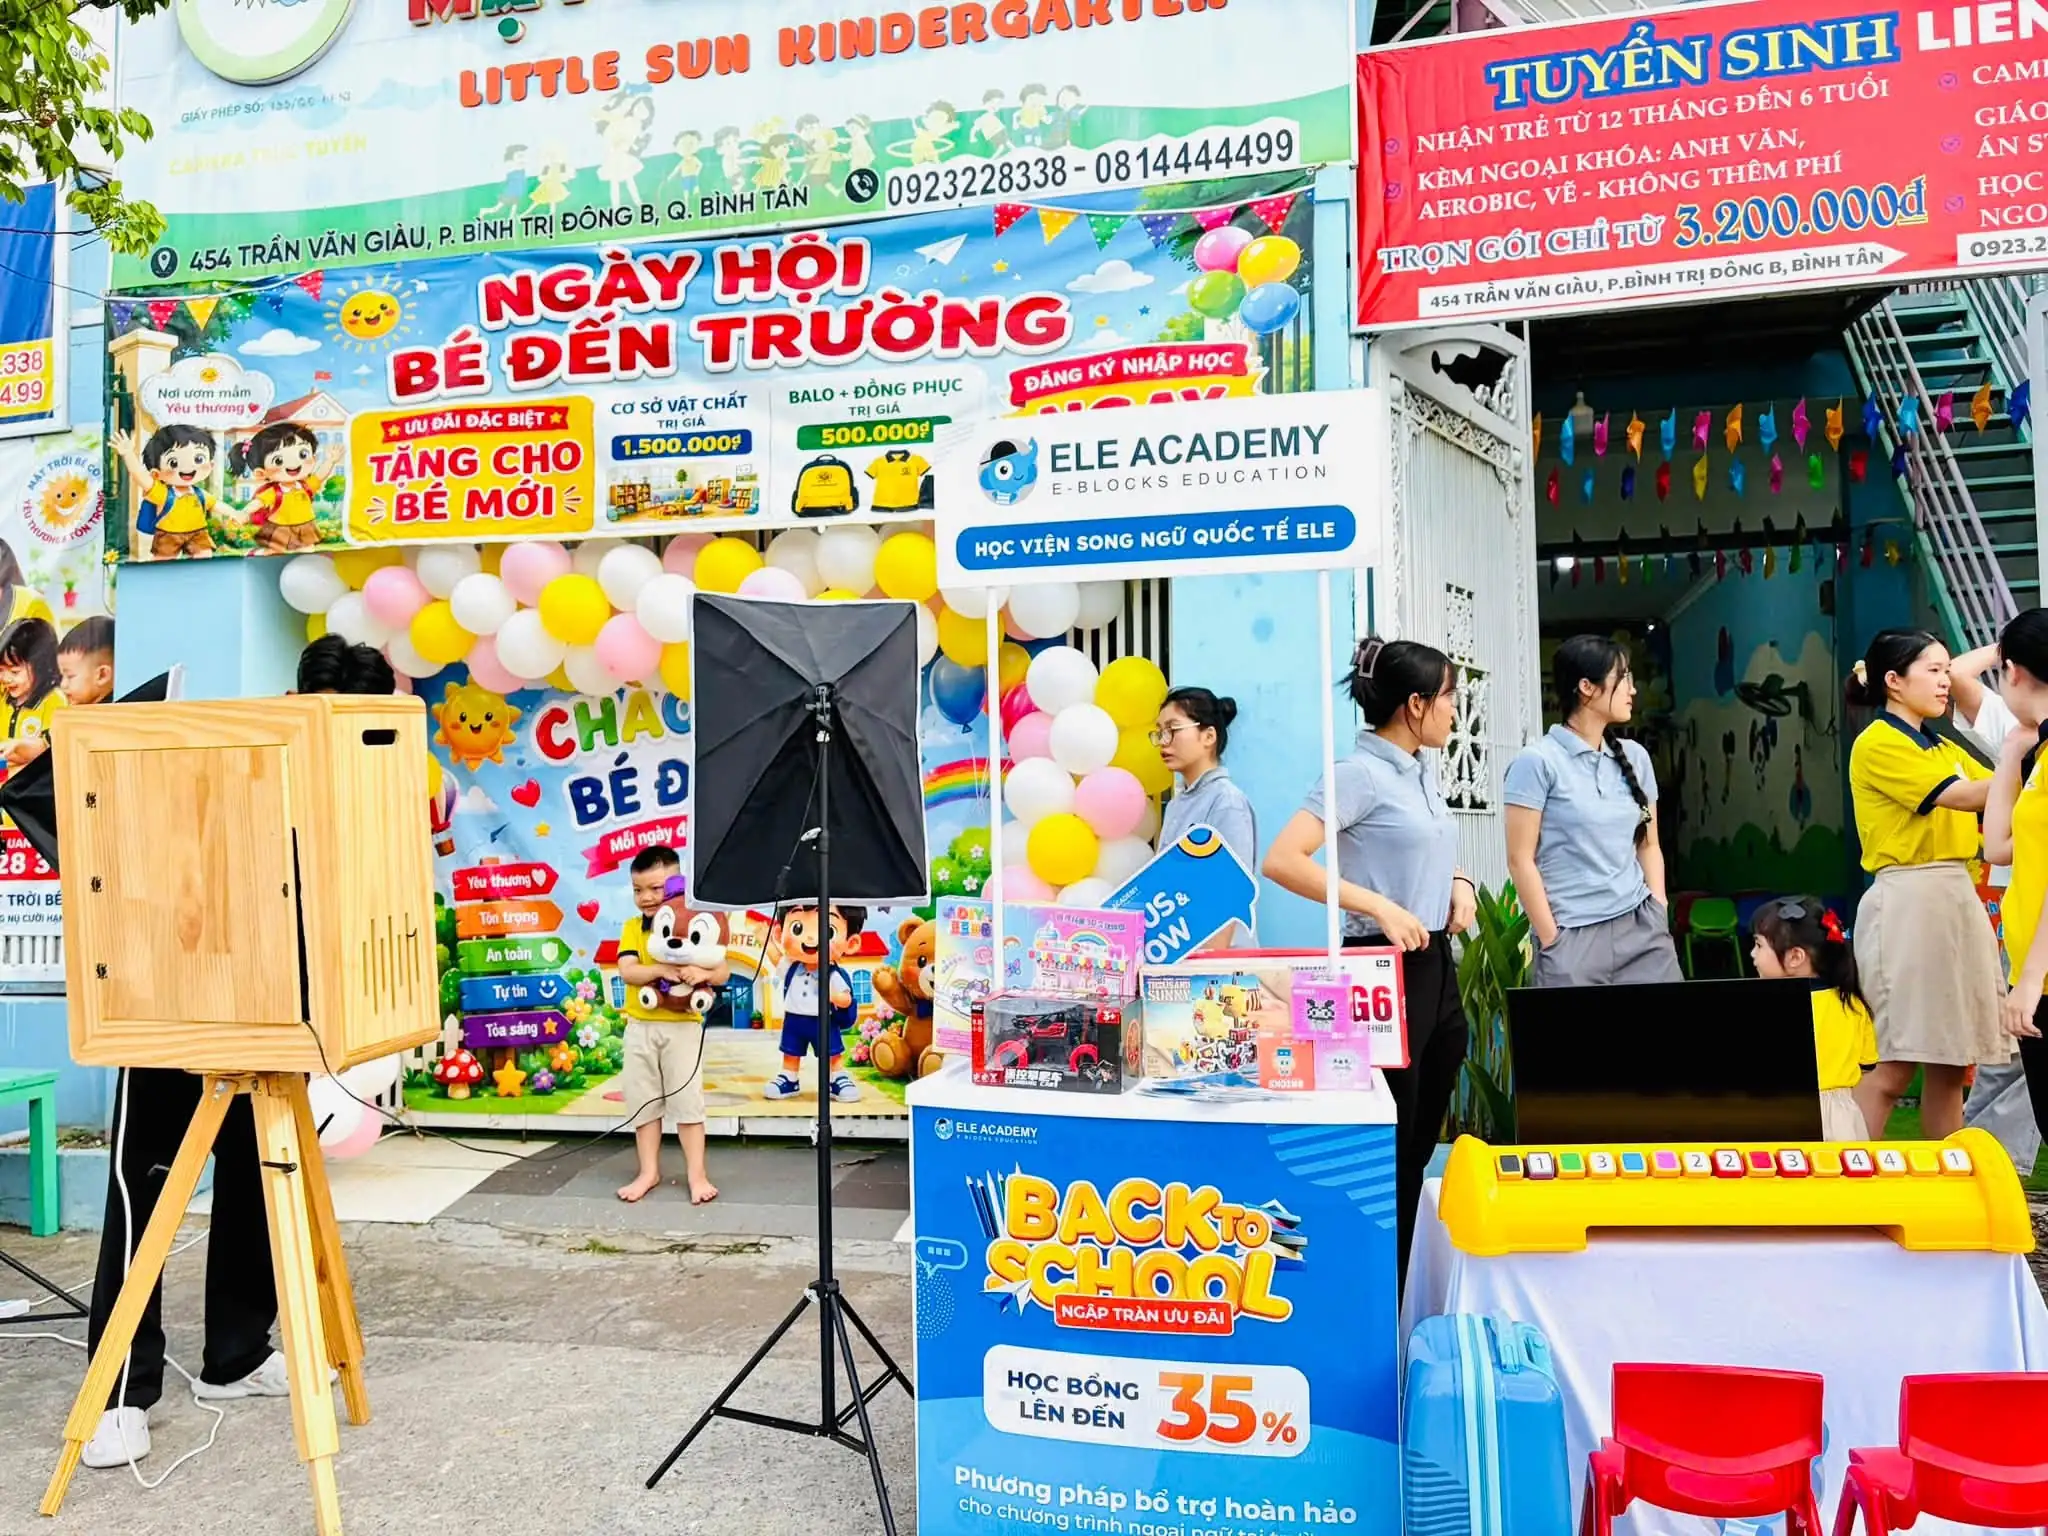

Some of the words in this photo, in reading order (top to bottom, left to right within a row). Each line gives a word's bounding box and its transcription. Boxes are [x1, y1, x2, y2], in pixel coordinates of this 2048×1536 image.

[460, 51, 619, 107] LITTLE
[646, 34, 750, 84] SUN
[1490, 25, 1706, 106] TUYỂN
[1726, 17, 1893, 76] SINH
[1416, 125, 1494, 153] NHẬN
[1500, 114, 1549, 141] TRẺ
[1555, 111, 1592, 134] TỪ
[1599, 111, 1623, 130] 12
[1628, 96, 1728, 124] THÁNG
[1736, 84, 1792, 114] ĐẾN
[1800, 90, 1813, 107] 6
[1819, 72, 1889, 103] TUỔI
[1975, 98, 2048, 127] GIÁO
[1418, 165, 1474, 191] KÈM
[1480, 155, 1568, 183] NGOẠI
[1576, 146, 1663, 174] KHÓA:
[1668, 138, 1729, 160] ANH
[1739, 127, 1805, 151] VĂN,
[1976, 134, 2019, 158] ÁN
[887, 155, 1068, 207] 0923228338
[1094, 129, 1295, 184] 0814444499
[1418, 191, 1537, 221] AEROBIC,
[1544, 181, 1577, 204] VẼ
[1598, 170, 1700, 200] KHÔNG
[1707, 160, 1787, 187] THÊM
[1796, 151, 1843, 176] PHÍ
[1978, 171, 2044, 199] HỌC
[190, 248, 232, 271] 454
[239, 234, 301, 266] TRẦN
[308, 230, 356, 258] VĂN
[364, 221, 432, 253] GIÀU,
[439, 227, 456, 246] P.
[463, 215, 514, 242] BÌNH
[520, 214, 553, 241] TRỊ
[561, 204, 633, 232] ĐÔNG
[640, 204, 660, 227] B,
[667, 200, 693, 220] Q.
[700, 190, 754, 217] BÌNH
[762, 184, 808, 209] TÂN
[1379, 239, 1469, 274] TRỌN
[1478, 229, 1540, 260] GÓI
[1546, 217, 1610, 253] CHỈ
[1615, 212, 1666, 245] TỪ
[485, 251, 695, 324] NGÀY
[721, 236, 868, 303] HỘI
[1431, 295, 1460, 308] 454
[1465, 281, 1511, 304] TRẦN
[1515, 282, 1550, 300] VĂN
[1555, 274, 1603, 297] GIÀU,
[1608, 268, 1672, 291] P.BÌNH
[1677, 268, 1705, 286] TRỊ
[1710, 258, 1764, 280] ĐÔNG
[1770, 261, 1787, 276] B,
[1792, 253, 1841, 272] BÌNH
[1846, 250, 1884, 267] TÂN
[392, 332, 485, 396] BÉ
[508, 313, 670, 384] ĐẾN
[701, 293, 1066, 366] TRƯỜNG
[1024, 368, 1082, 393] ĐĂNG
[1088, 358, 1116, 380] KÝ
[1122, 352, 1182, 376] NHẬP
[1188, 351, 1234, 371] HỌC
[158, 388, 179, 398] Nơi
[166, 403, 190, 413] Yêu
[611, 401, 635, 415] CƠ
[641, 396, 665, 413] SỞ
[669, 396, 697, 413] VẬT
[703, 390, 748, 410] CHẤT
[789, 388, 834, 404] BALO
[840, 390, 848, 398] +
[853, 378, 906, 398] ĐỒNG
[913, 378, 963, 396] PHỤC
[848, 405, 871, 417] TRỊ
[875, 402, 901, 415] GIÁ
[405, 419, 427, 435] ƯU
[432, 413, 460, 431] ĐÃI
[466, 410, 503, 430] ĐẶC
[508, 410, 544, 429] BIỆT
[657, 419, 679, 430] TRỊ
[683, 416, 705, 428] GIÁ
[369, 445, 478, 487] TẶNG
[493, 441, 581, 475] CHO
[1050, 438, 1119, 473] ELE
[1130, 423, 1329, 468] ACADEMY
[1052, 475, 1170, 496] E-BLOCKS
[1182, 465, 1328, 487] EDUCATION
[395, 482, 448, 521] BÉ
[466, 479, 553, 519] MỚI
[975, 539, 1014, 560] HỌC
[1020, 533, 1070, 557] VIỆN
[1076, 531, 1133, 551] SONG
[1140, 526, 1187, 548] NGỮ
[1193, 520, 1255, 546] QUỐC
[1261, 517, 1290, 542] TẾ
[1296, 521, 1336, 540] ELE
[569, 752, 640, 825] BÉ
[467, 875, 487, 888] Yêu
[486, 949, 502, 962] An
[493, 984, 510, 999] Tự
[512, 983, 528, 995] tin
[510, 1022, 538, 1037] sáng
[956, 1121, 977, 1133] ELE
[980, 1124, 1038, 1138] ACADEMY
[1534, 1154, 1545, 1170] 1
[1596, 1154, 1608, 1170] 3
[1692, 1154, 1703, 1168] 2
[1724, 1154, 1736, 1169] 2
[1787, 1154, 1799, 1169] 3
[1851, 1154, 1864, 1169] 4
[1883, 1154, 1896, 1168] 4
[1950, 1153, 1960, 1167] 1
[1004, 1174, 1223, 1251] BACK
[1213, 1204, 1269, 1248] TO
[986, 1240, 1291, 1320] SCHOOL
[1061, 1303, 1108, 1321] NGẬP
[1112, 1305, 1159, 1323] TRÀN
[1163, 1306, 1188, 1323] ƯU
[1193, 1306, 1225, 1325] ĐÃI
[1008, 1370, 1059, 1394] HỌC
[1067, 1373, 1139, 1400] BỔNG
[1020, 1398, 1065, 1423] LÊN
[1072, 1403, 1125, 1429] ĐẾN
[955, 1465, 1051, 1505] Phương
[1060, 1483, 1127, 1512] pháp
[1135, 1489, 1169, 1513] bổ
[1177, 1494, 1217, 1521] trợ
[1226, 1496, 1295, 1522] hoàn
[1304, 1499, 1357, 1524] hảo
[959, 1496, 992, 1515] cho
[997, 1503, 1069, 1531] chương
[1075, 1513, 1123, 1533] trình
